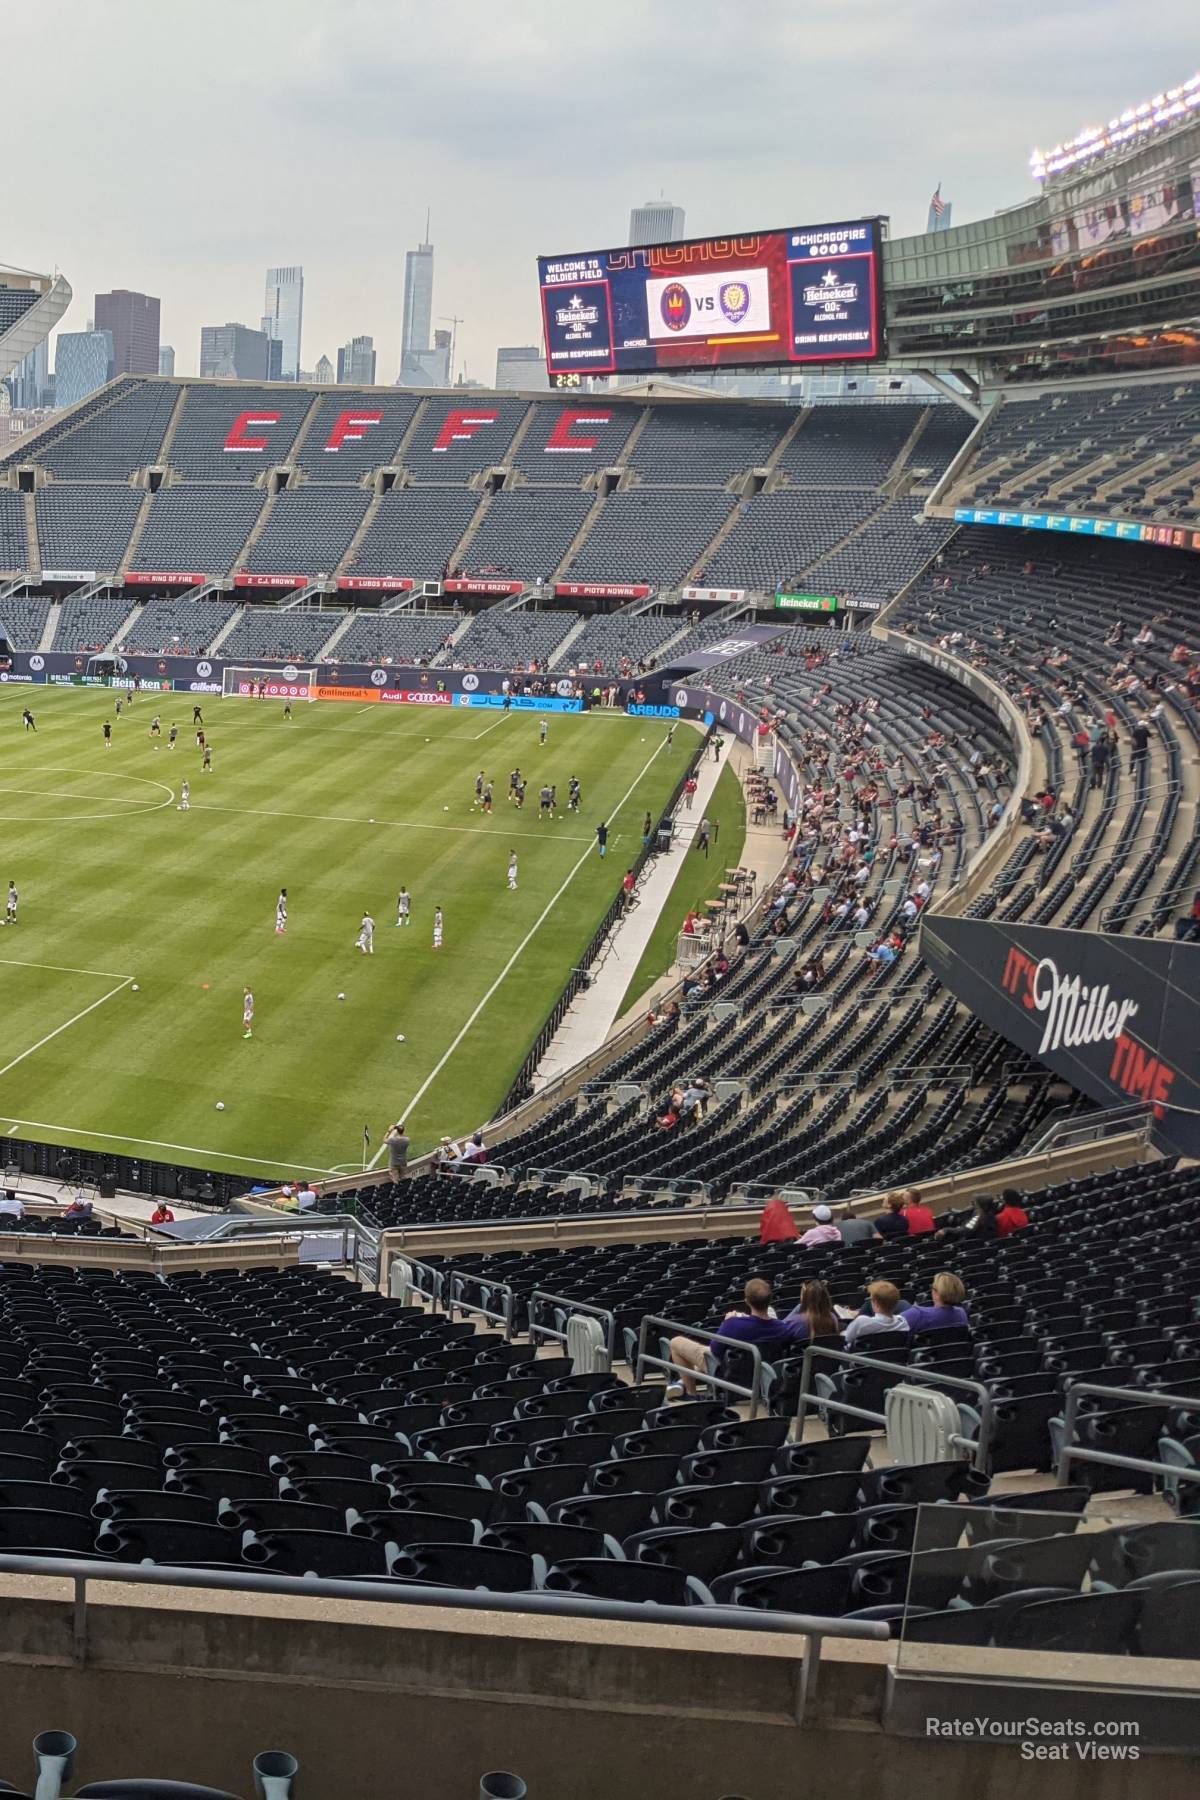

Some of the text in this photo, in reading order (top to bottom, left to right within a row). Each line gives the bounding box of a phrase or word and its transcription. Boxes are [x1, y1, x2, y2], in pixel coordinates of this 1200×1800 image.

[547, 260, 599, 274] WELCOME TO
[545, 269, 603, 283] SOLDIER FIELD
[695, 296, 715, 311] VS
[795, 332, 869, 344] DRINK RESPONSIBLY
[556, 374, 580, 387] 2:29
[780, 598, 819, 608] Heineken
[318, 687, 362, 697] Continental
[382, 692, 402, 700] Audi
[1033, 958, 1139, 1054] Miller
[1109, 1033, 1174, 1120] TIME
